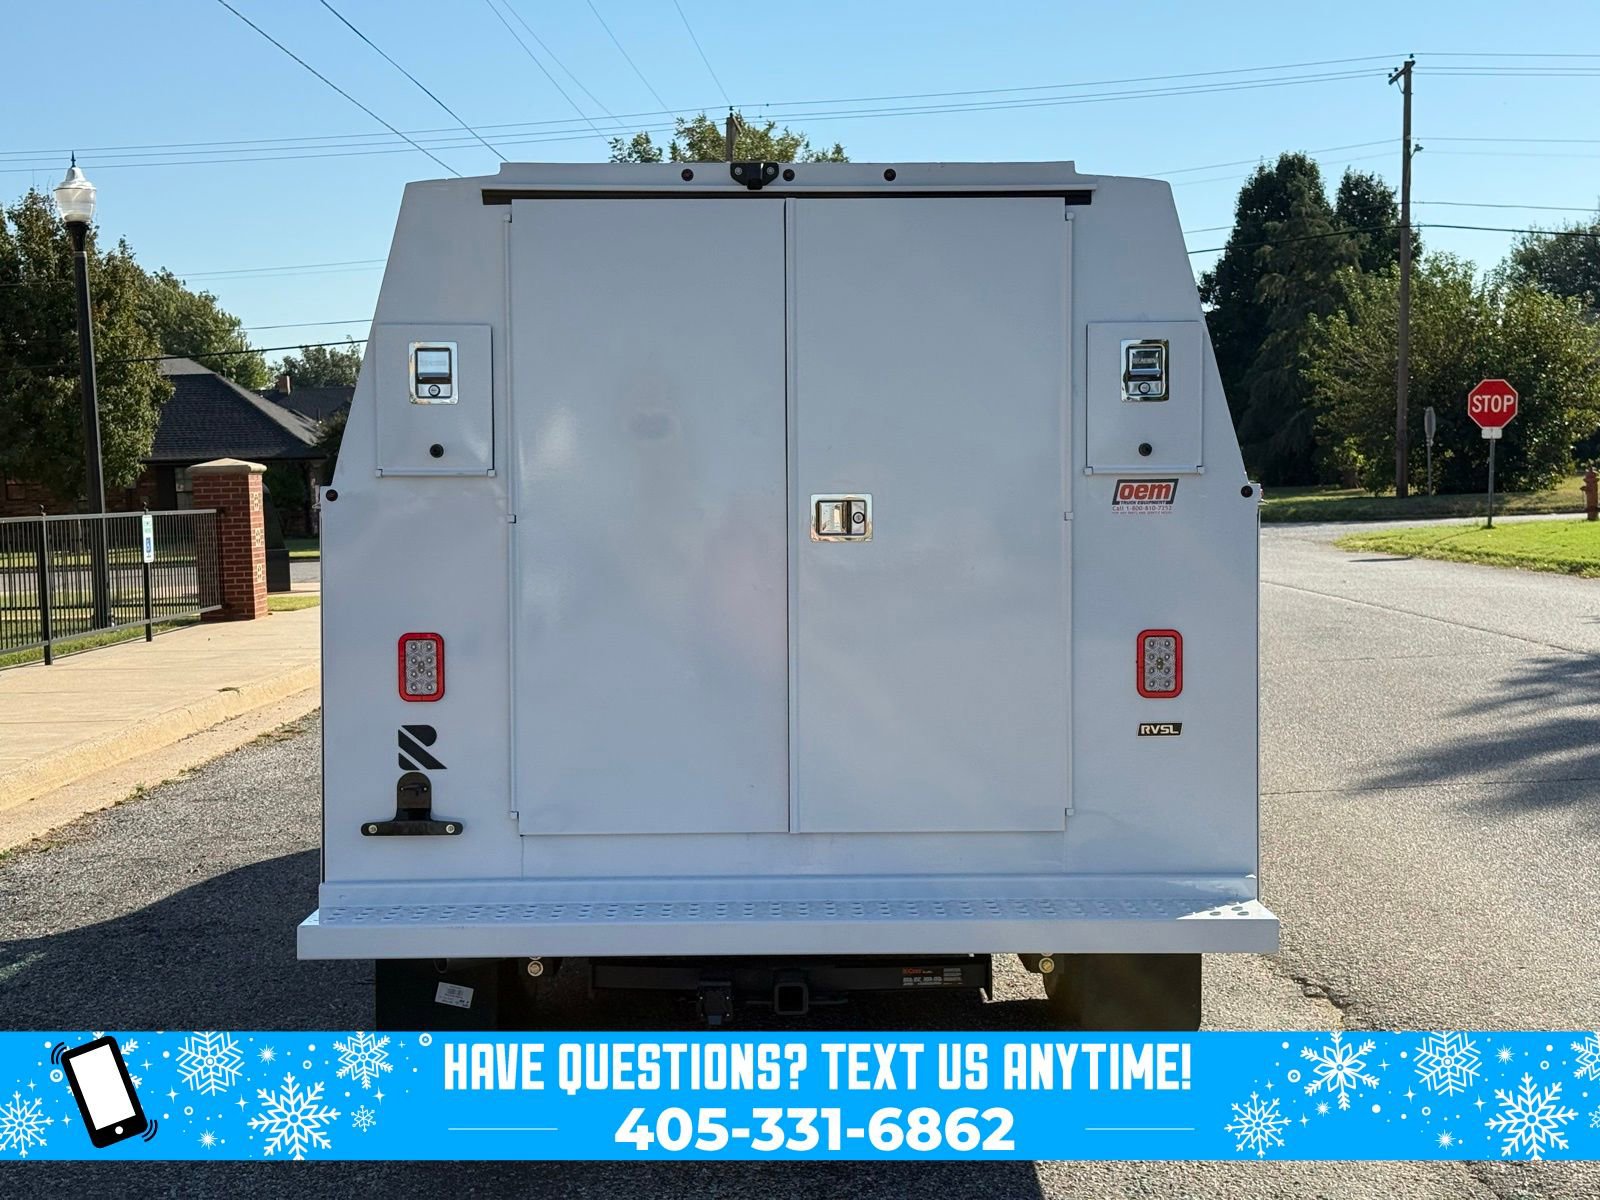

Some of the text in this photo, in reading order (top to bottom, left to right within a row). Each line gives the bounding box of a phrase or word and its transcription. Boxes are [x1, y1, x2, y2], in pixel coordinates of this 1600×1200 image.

[1472, 395, 1514, 413] STOP
[1120, 484, 1172, 500] oem
[1141, 724, 1179, 735] RVSL
